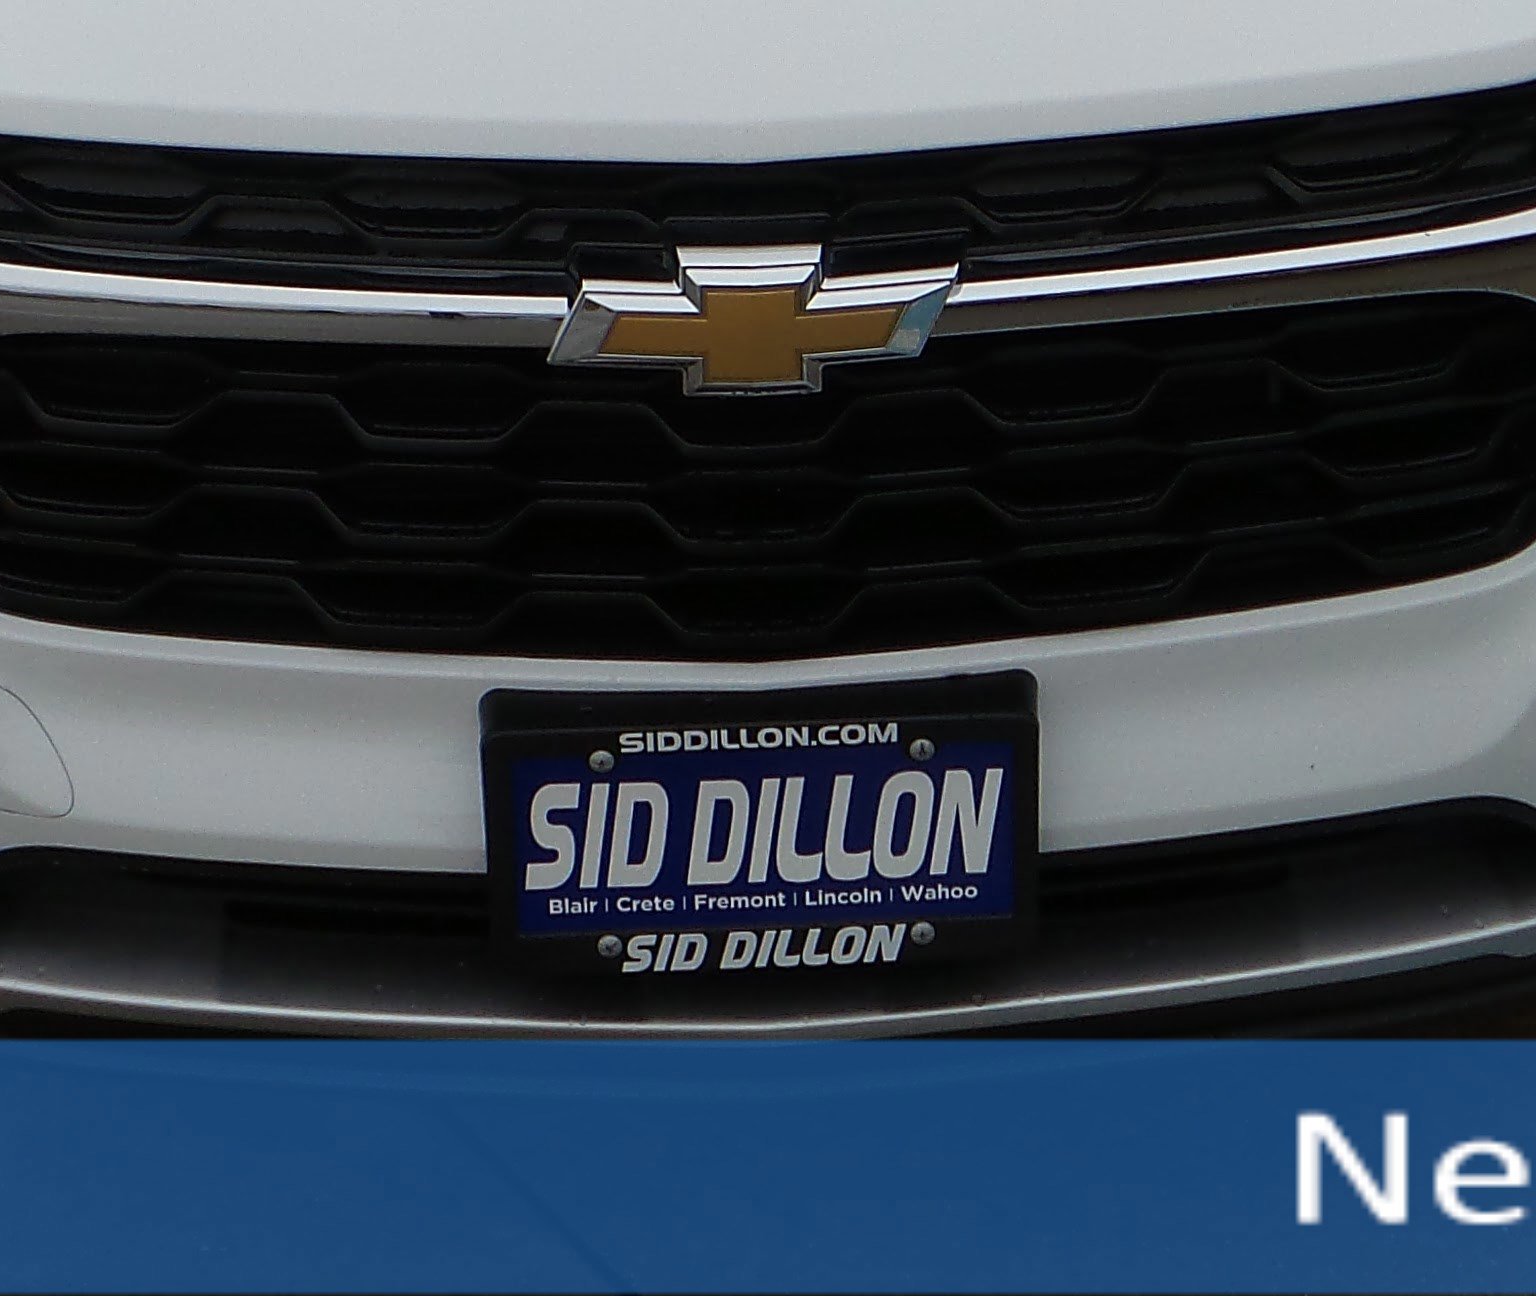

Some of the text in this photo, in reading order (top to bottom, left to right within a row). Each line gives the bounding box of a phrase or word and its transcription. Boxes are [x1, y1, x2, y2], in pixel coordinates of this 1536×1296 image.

[618, 722, 899, 754] SIDDILLON.COM
[524, 767, 1004, 891] SID DILLON
[548, 883, 979, 915] Blair Crete Fremont Lincoln Wahoo
[621, 923, 907, 973] SID DILLON
